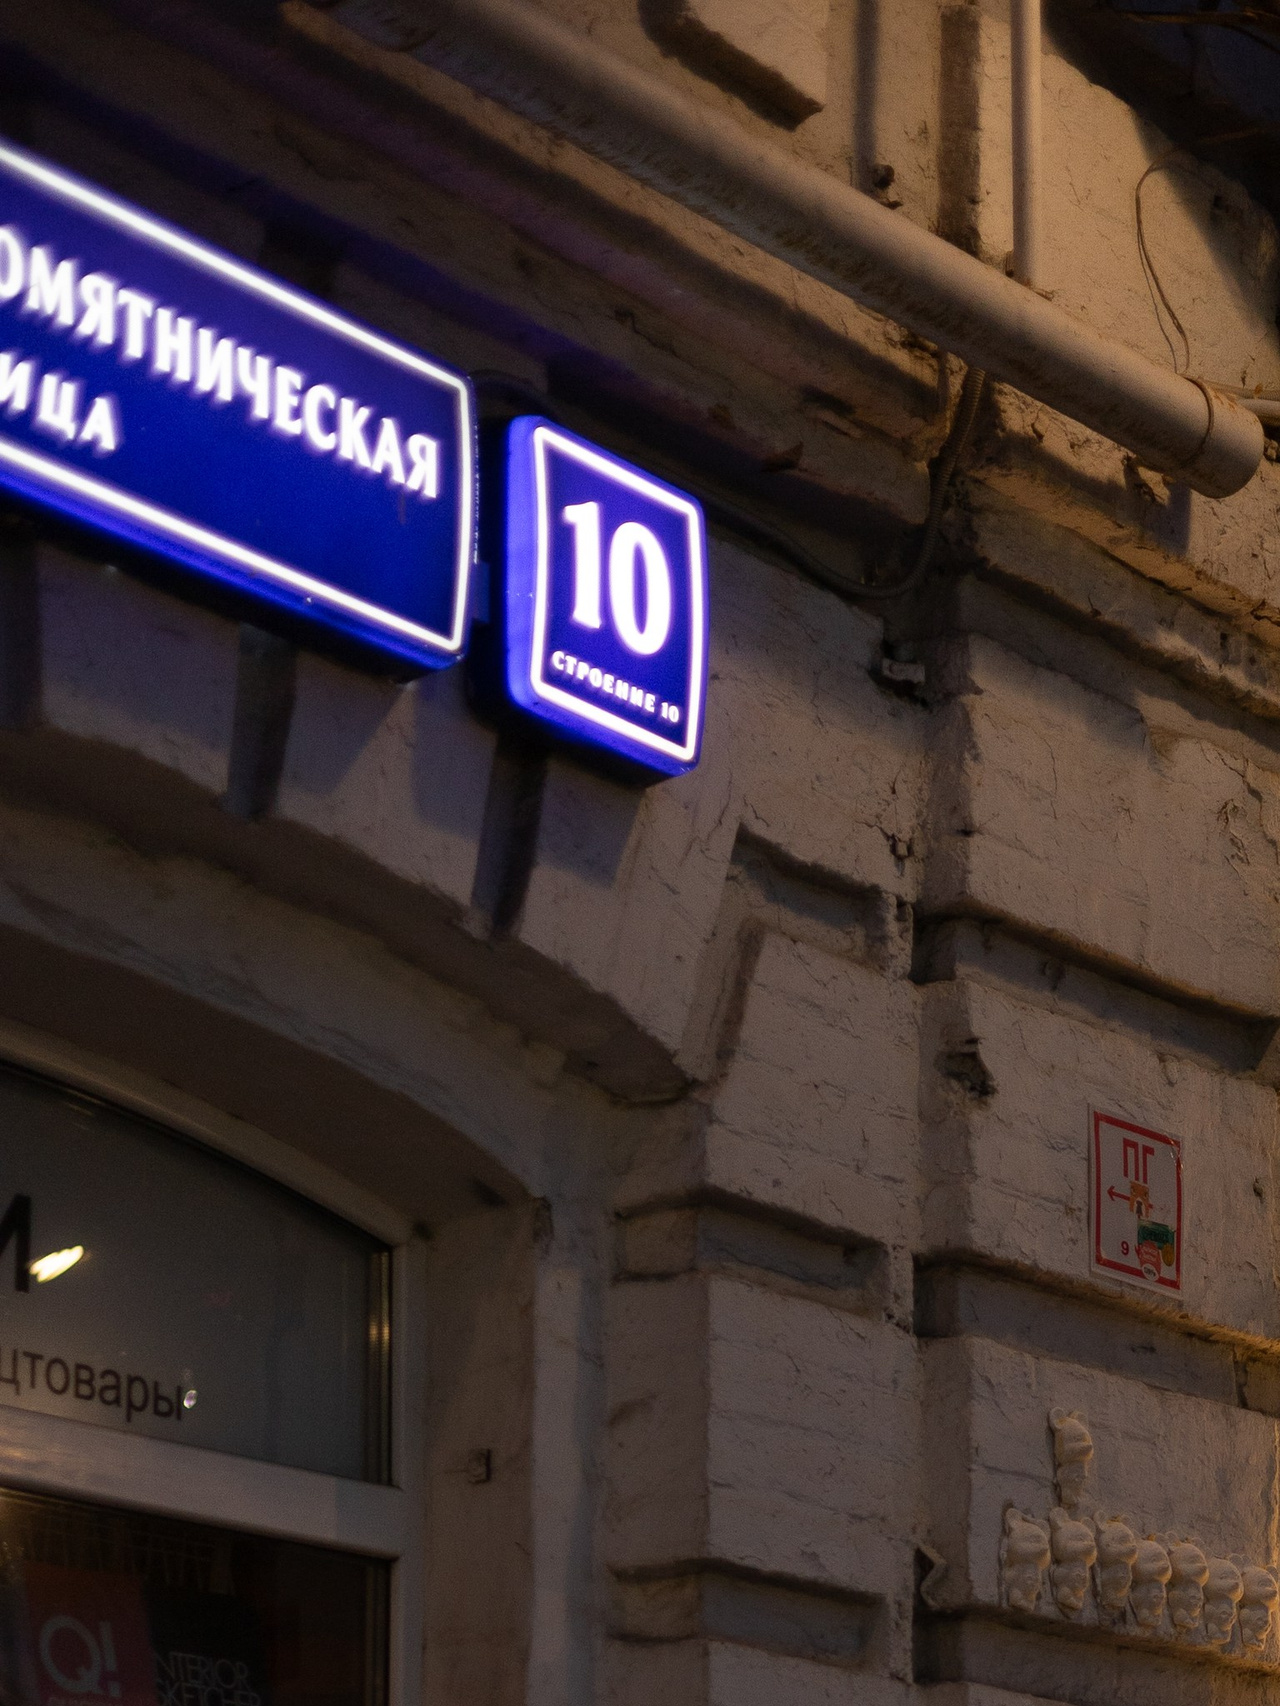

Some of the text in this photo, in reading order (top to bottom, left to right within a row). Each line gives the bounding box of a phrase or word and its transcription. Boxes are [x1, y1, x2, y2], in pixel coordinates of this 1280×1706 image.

[563, 500, 673, 656] 10
[551, 650, 680, 723] СТРОЕНИЕ 10
[1122, 1137, 1155, 1184] ПГ
[154, 1651, 252, 1692] NTERIOR
